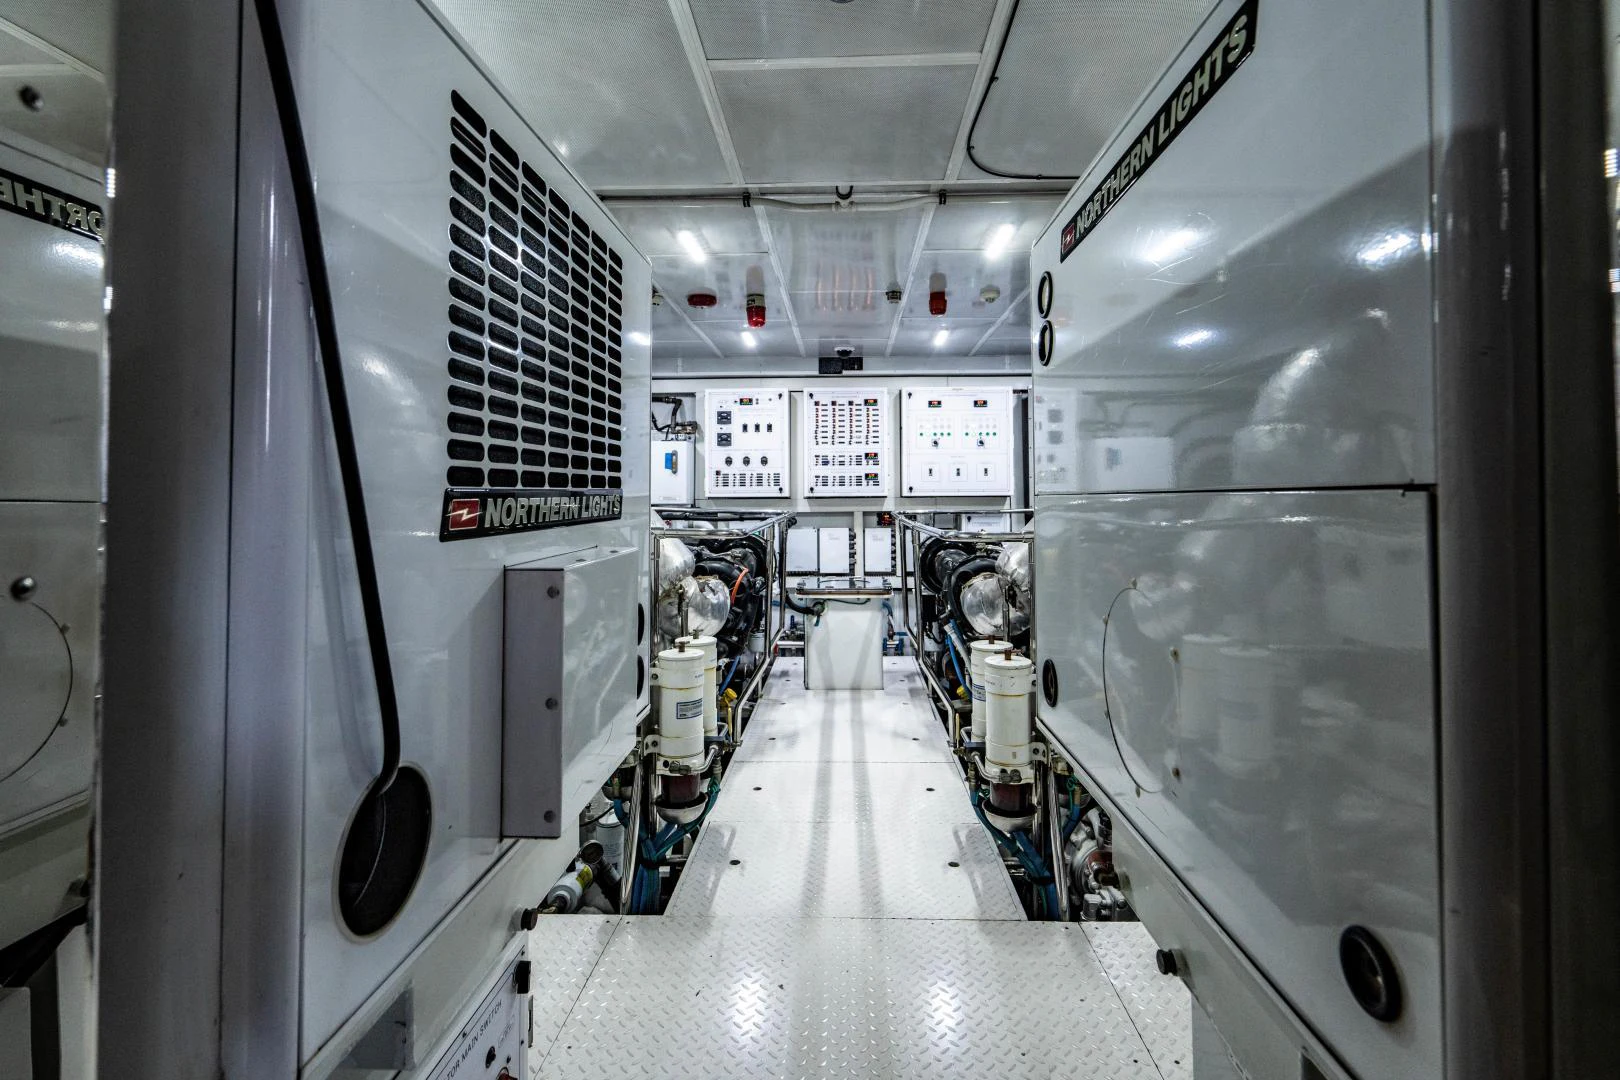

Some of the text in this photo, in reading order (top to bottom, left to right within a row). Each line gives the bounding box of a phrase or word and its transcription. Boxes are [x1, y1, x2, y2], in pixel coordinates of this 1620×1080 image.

[1074, 14, 1248, 238] NORTHERN LIGHTS
[484, 493, 621, 528] NORTHERN LIGHTS
[461, 1031, 479, 1062] MAIN
[480, 999, 502, 1036] SWITCH
